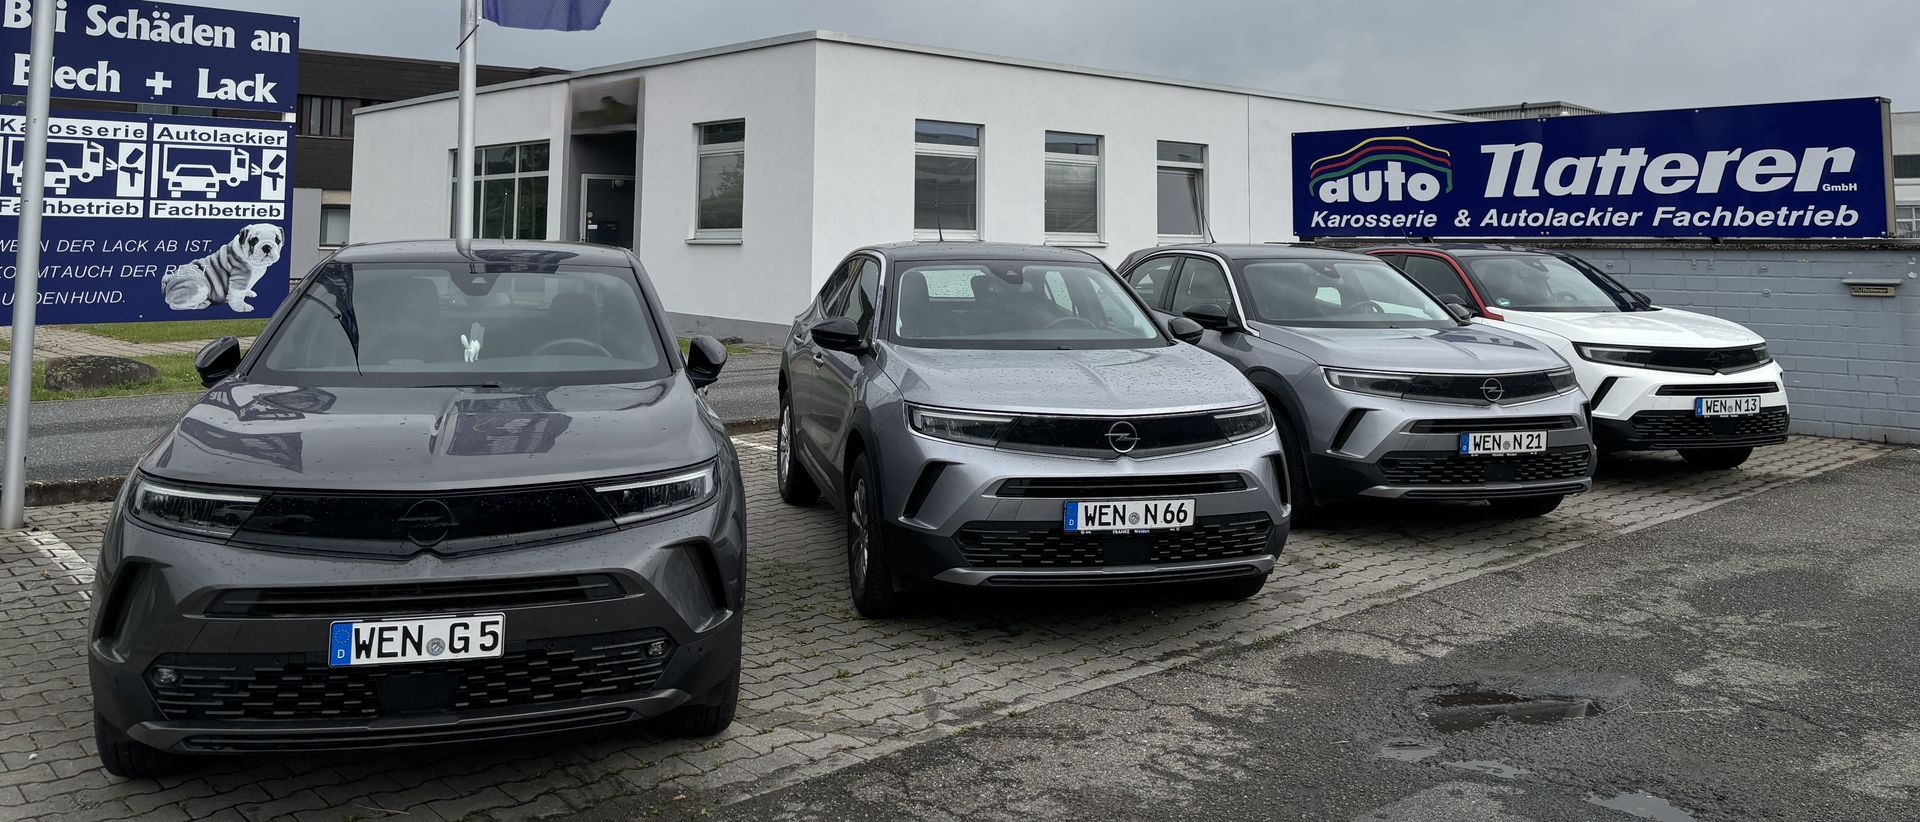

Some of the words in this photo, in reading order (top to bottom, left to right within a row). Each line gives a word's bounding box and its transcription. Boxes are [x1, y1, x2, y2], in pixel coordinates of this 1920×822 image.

[3, 0, 67, 33] Bi
[86, 4, 235, 49] Schäden
[250, 28, 291, 53] an
[146, 72, 172, 95] +
[197, 68, 277, 103] Lack
[0, 118, 145, 138] Kaosserie
[157, 127, 284, 146] Autolackier
[1319, 161, 1440, 203] auto
[1480, 142, 1856, 198] Natterer
[1822, 183, 1858, 192] GmbH
[0, 199, 139, 215] Fahbetrieb
[154, 202, 281, 218] Fachbetrieb
[1311, 209, 1438, 228] Karosserie
[1454, 209, 1471, 228] &
[1480, 207, 1643, 227] Autolackier
[1652, 204, 1859, 227] Fachbetrieb
[0, 239, 49, 253] WEN
[57, 239, 95, 252] DER
[102, 239, 149, 252] LACK
[154, 240, 178, 252] AB
[184, 239, 212, 253] IST,
[120, 265, 157, 278] DER
[164, 264, 210, 278] REST
[70, 290, 126, 304] HUND.
[1706, 399, 1727, 413] WEN
[1735, 399, 1741, 412] N
[1745, 398, 1757, 412] 13
[1473, 434, 1501, 451] WEN
[1513, 434, 1522, 450] N
[1526, 433, 1542, 449] 21
[1084, 504, 1126, 527] WEN
[1145, 503, 1158, 525] N
[1163, 502, 1188, 524] 66
[337, 649, 345, 659] D
[354, 624, 424, 659] WEN
[448, 622, 470, 654] G
[479, 620, 500, 652] 5
